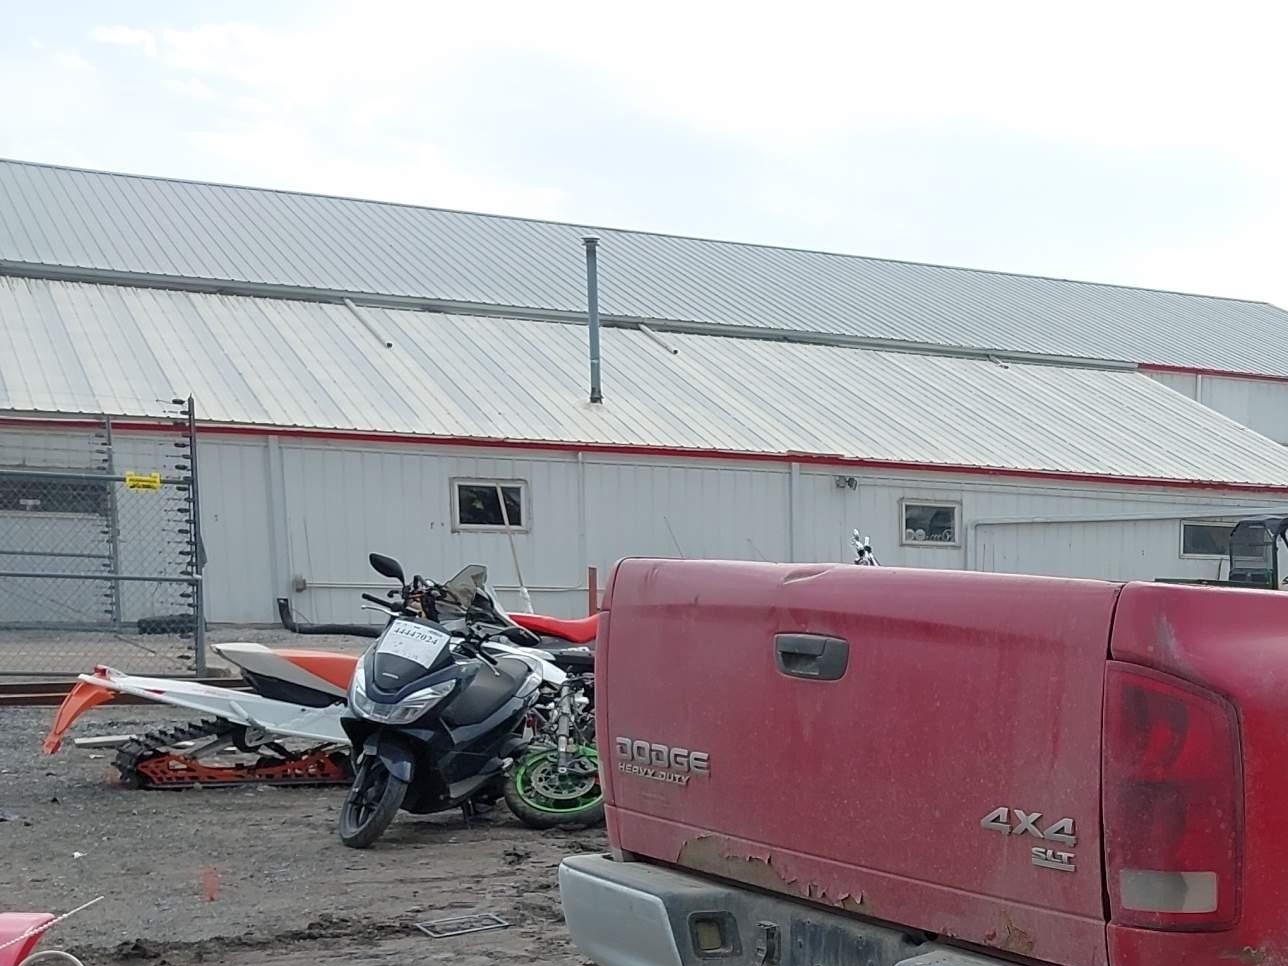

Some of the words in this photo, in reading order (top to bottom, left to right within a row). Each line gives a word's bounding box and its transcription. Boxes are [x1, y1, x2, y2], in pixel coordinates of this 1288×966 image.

[616, 736, 709, 775] DODGE
[618, 761, 656, 778] HEAVY
[658, 770, 690, 786] DUTY
[980, 806, 1077, 848] 4X4
[1031, 846, 1075, 866] SLT
